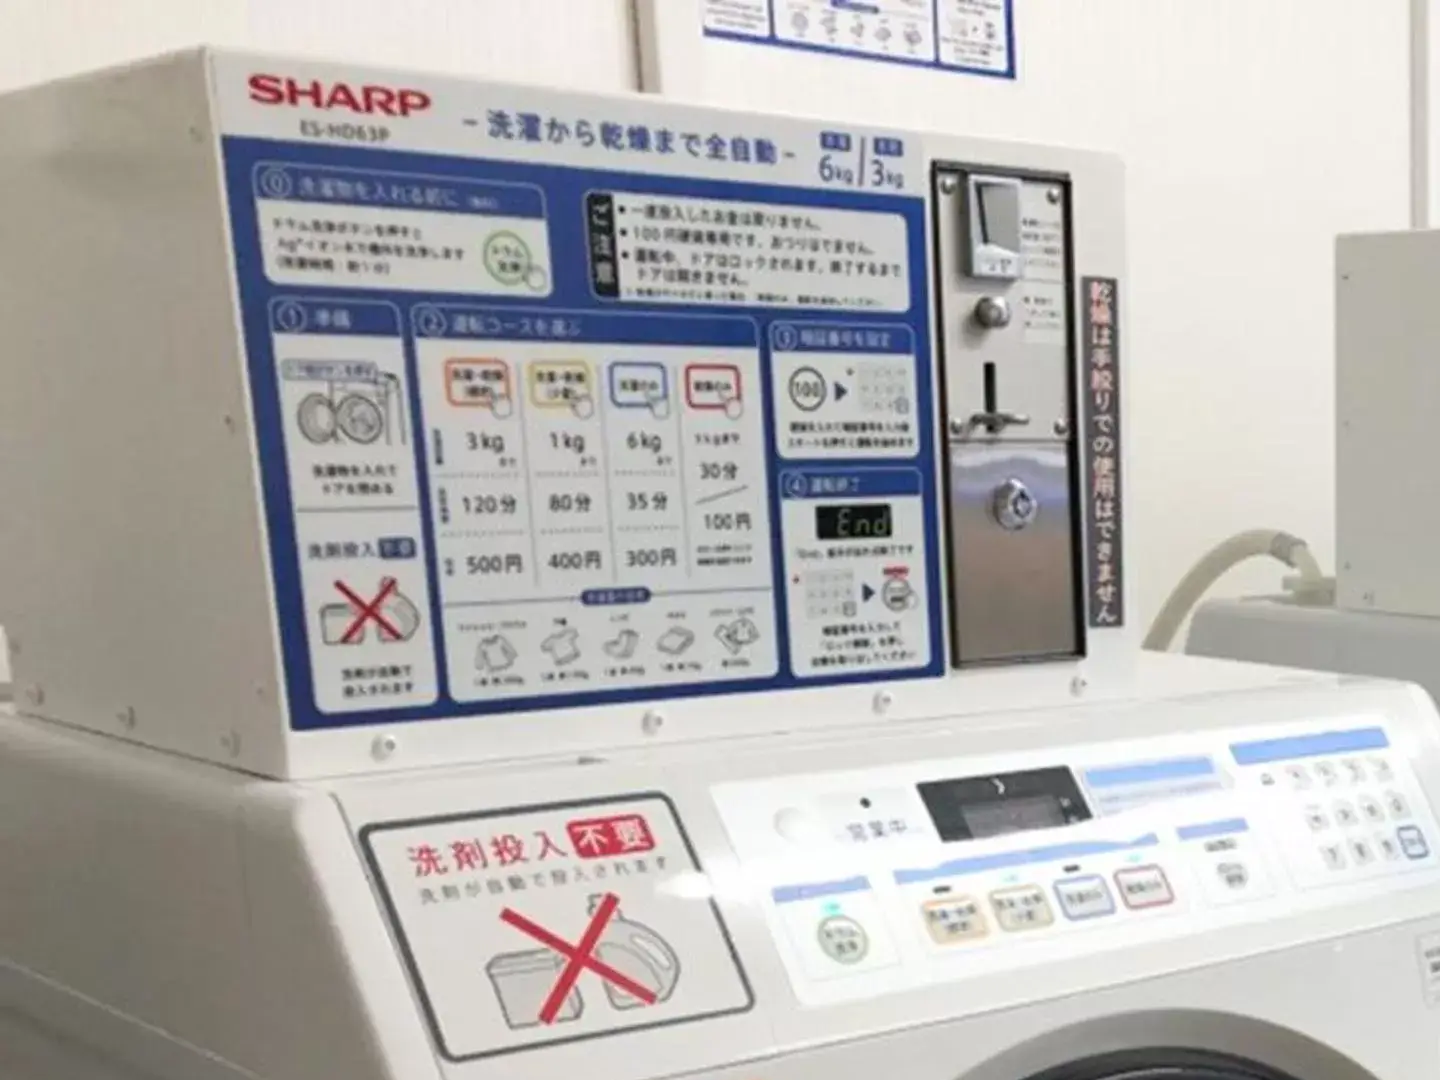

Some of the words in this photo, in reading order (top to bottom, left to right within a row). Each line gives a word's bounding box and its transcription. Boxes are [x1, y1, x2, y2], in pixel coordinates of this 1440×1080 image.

[247, 73, 433, 118] SHARP
[300, 120, 390, 142] ES-HD63P
[699, 461, 739, 481] 30分
[462, 496, 517, 515] 120分
[549, 493, 593, 513] 80分
[626, 491, 669, 511] 35分
[702, 511, 753, 531] 100円
[836, 508, 890, 537] End
[465, 553, 524, 575] 500円
[547, 549, 603, 570] 400円
[626, 546, 678, 567] 300円
